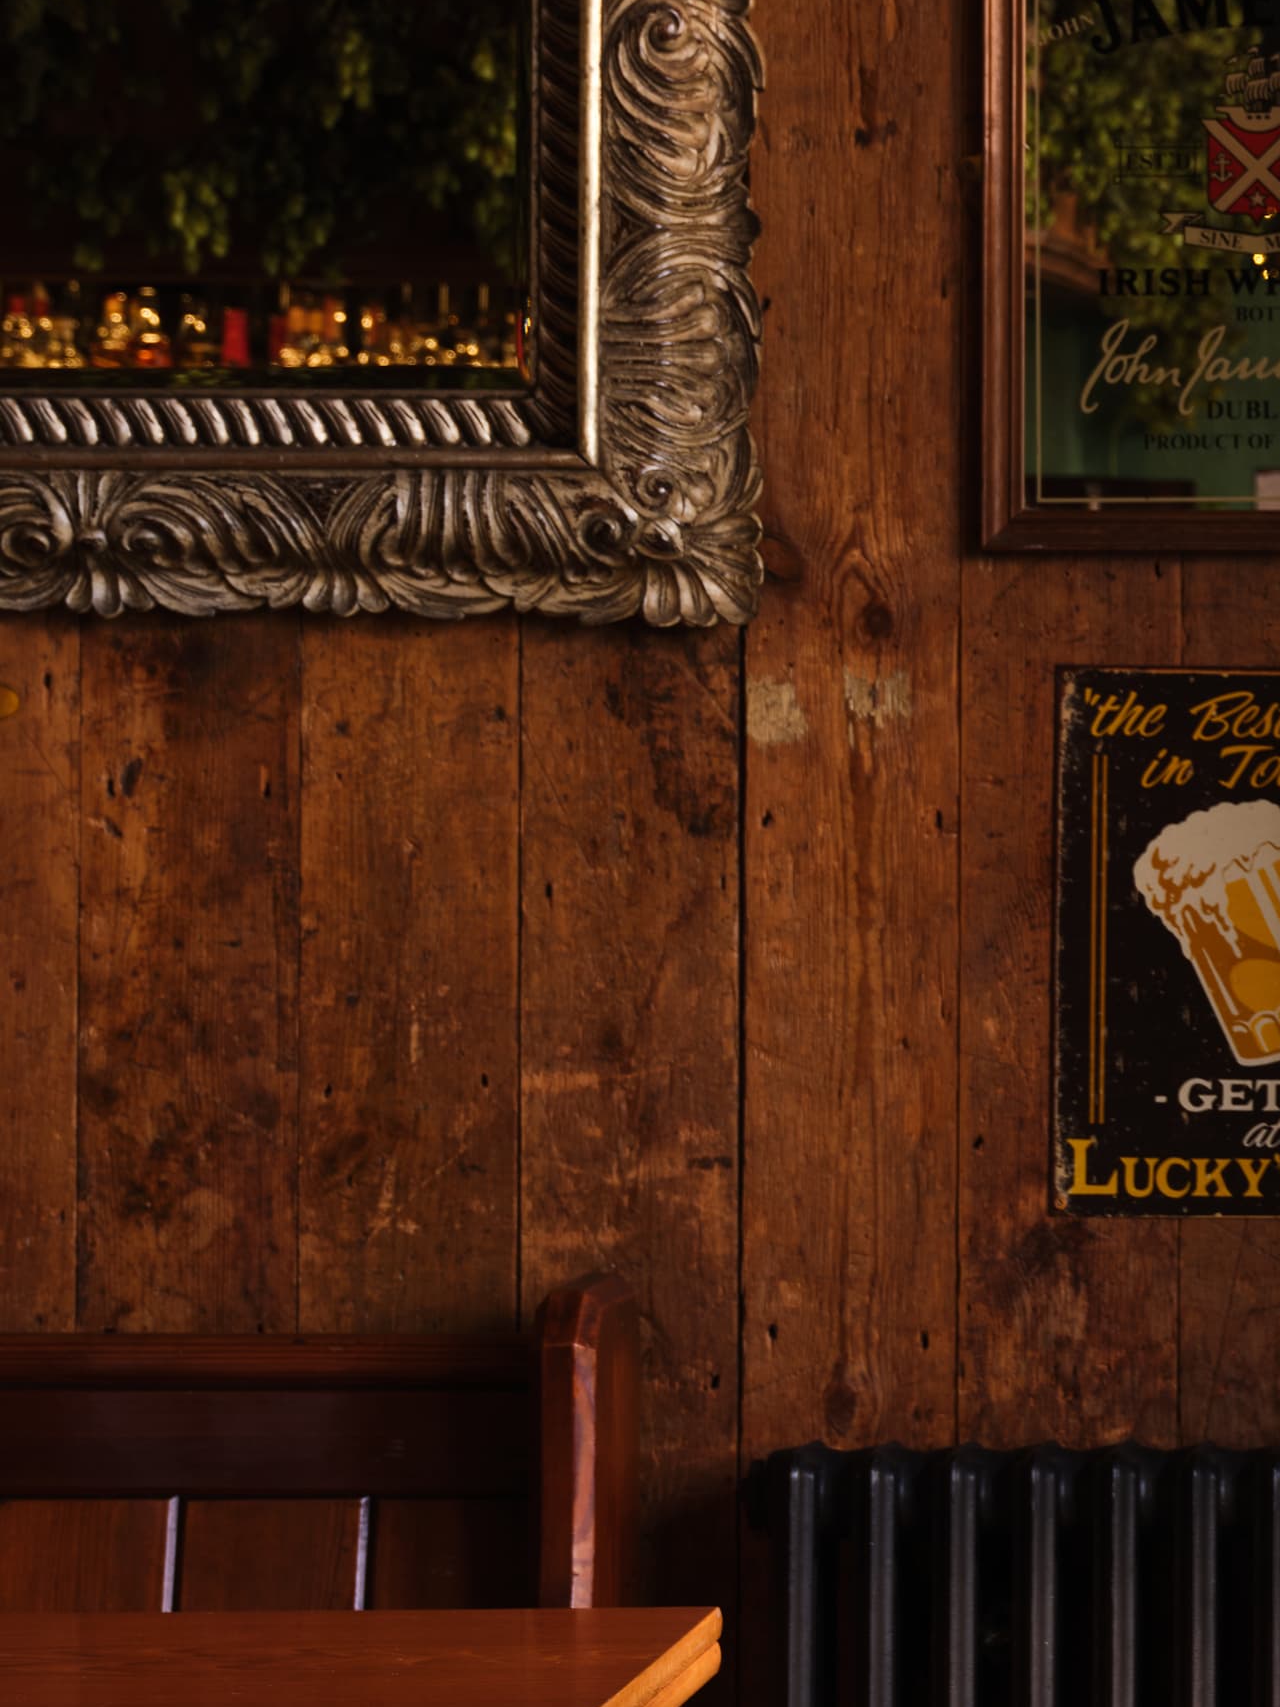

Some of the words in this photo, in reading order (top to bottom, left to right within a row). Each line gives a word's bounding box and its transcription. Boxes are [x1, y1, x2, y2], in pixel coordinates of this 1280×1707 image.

[1200, 230, 1243, 250] SINE
[1100, 268, 1209, 295] IRISH
[1079, 318, 1182, 415] John
[1144, 434, 1240, 450] PRODUCT
[1247, 433, 1273, 450] OF
[1140, 748, 1195, 790] in
